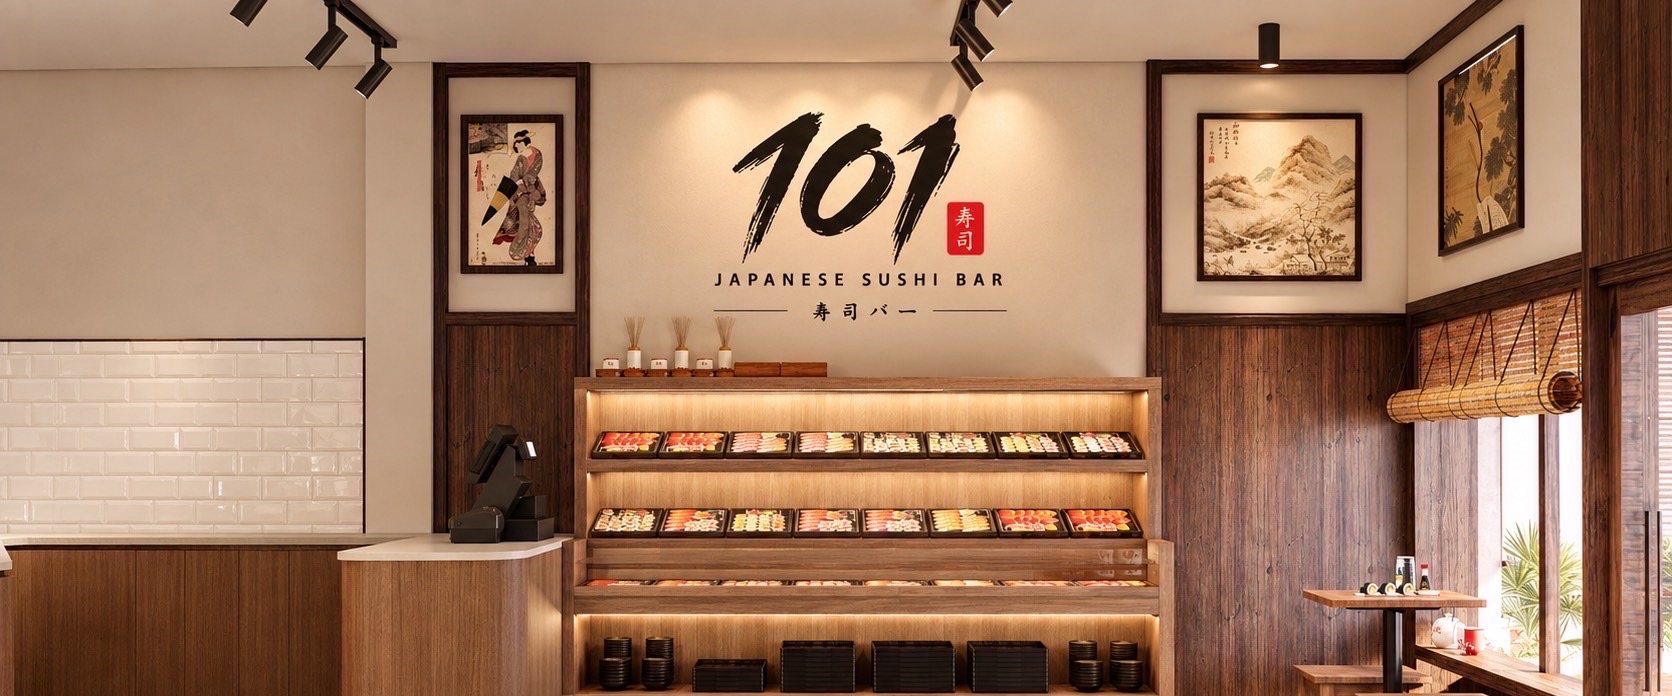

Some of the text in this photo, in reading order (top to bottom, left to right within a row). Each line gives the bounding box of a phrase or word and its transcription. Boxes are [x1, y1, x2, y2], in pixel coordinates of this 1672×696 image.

[732, 112, 960, 266] 101
[955, 207, 975, 252] 寿司
[714, 272, 1003, 287] JAPANESE SUSHI BAR
[813, 302, 917, 321] 寿司バー
